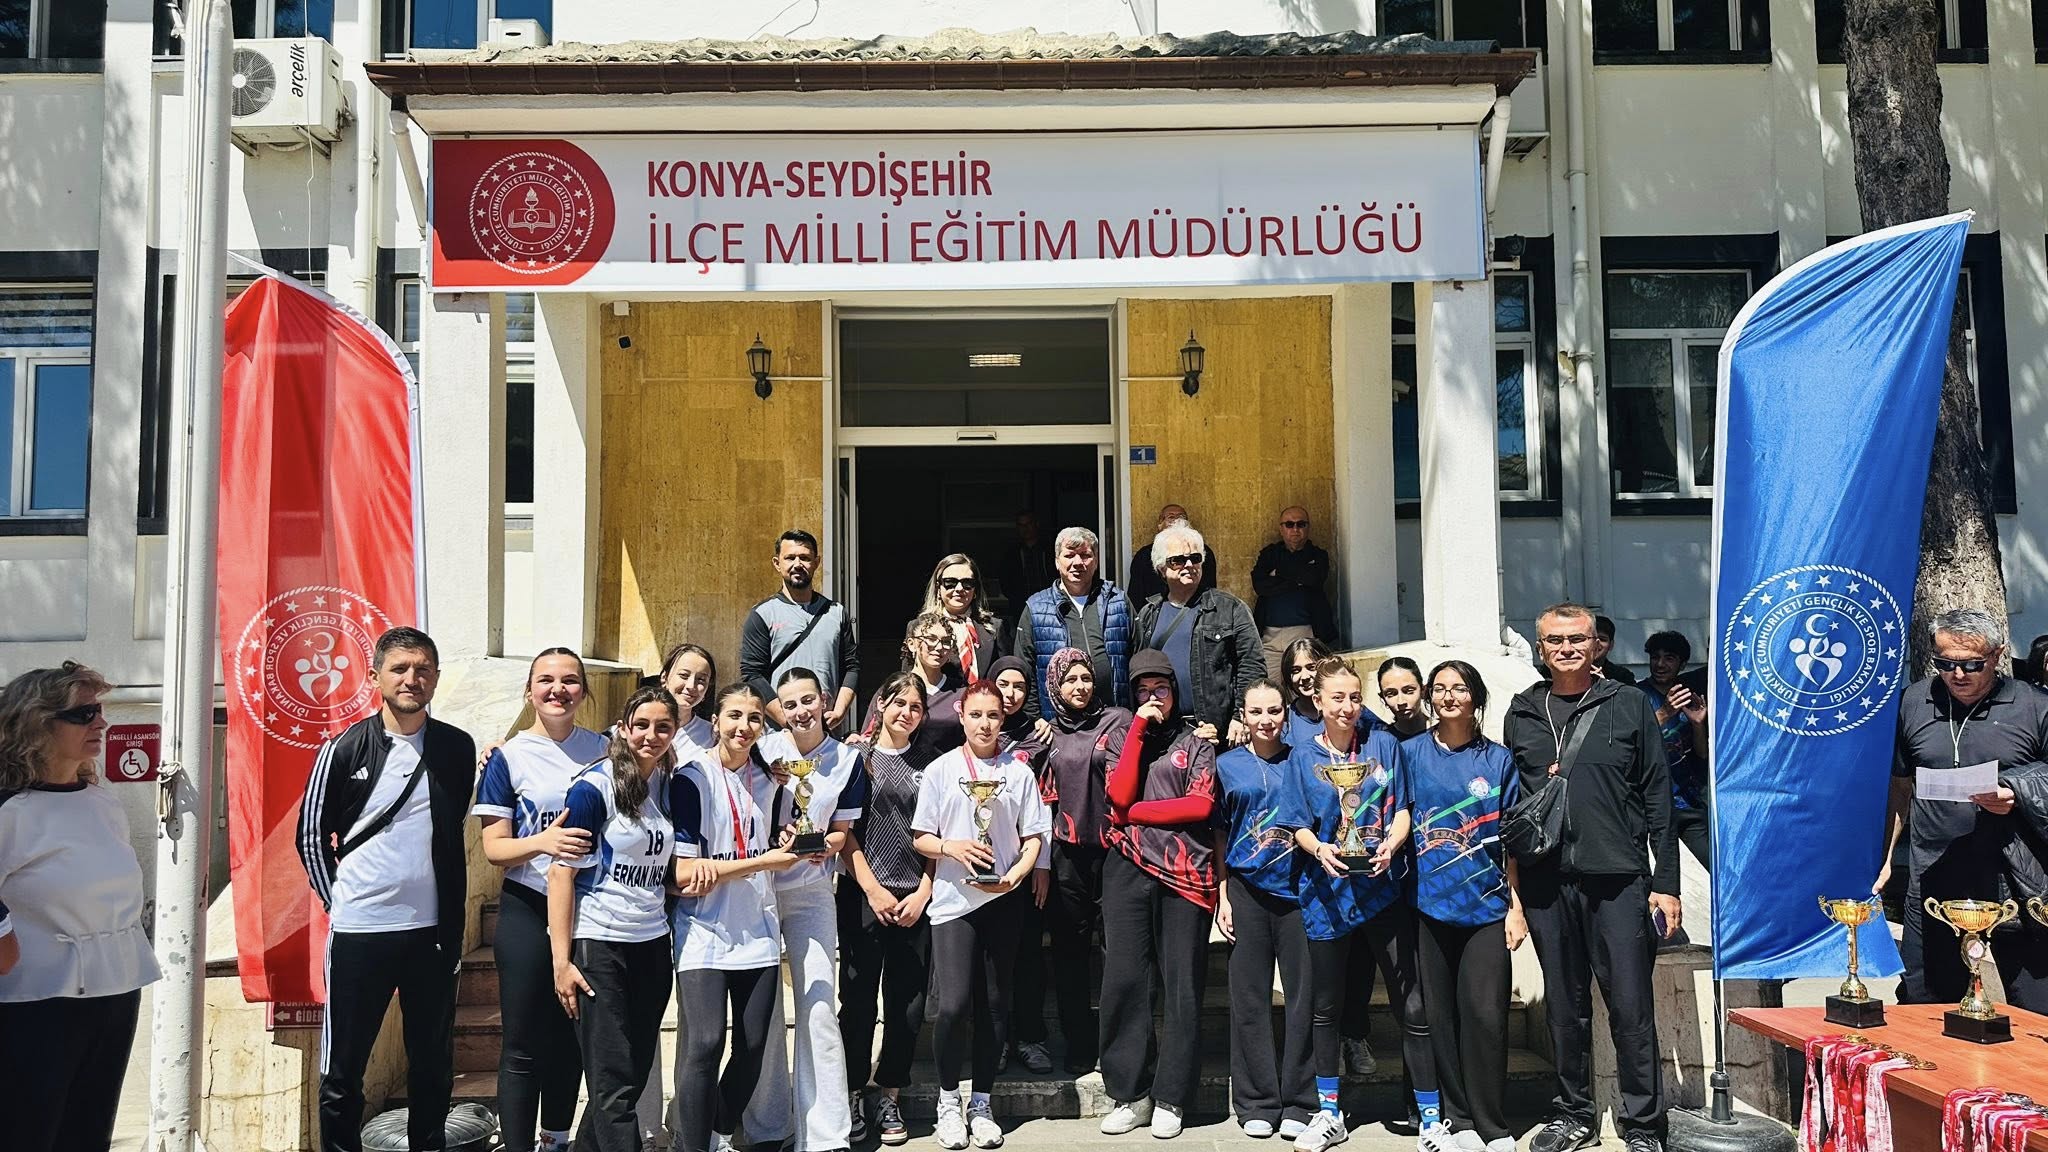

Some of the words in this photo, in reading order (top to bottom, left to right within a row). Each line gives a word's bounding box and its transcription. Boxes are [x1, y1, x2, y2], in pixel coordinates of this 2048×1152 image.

[290, 43, 307, 98] arçelik
[528, 174, 552, 185] MİLLİ
[648, 151, 993, 206] KONYA-SEYDİŞEHİR
[491, 174, 527, 222] CUMHURİYETİ
[552, 182, 572, 210] EĞİTİM
[495, 223, 525, 251] TÜRKİYE
[540, 211, 572, 251] BAKANLIĞI
[650, 212, 745, 274] İLÇE
[765, 212, 889, 264] MİLLİ
[910, 209, 1077, 262] EĞİTİM
[1098, 202, 1422, 259] MÜDÜRLÜĞÜ
[1137, 447, 1146, 461] 1
[1804, 596, 1857, 614] GENÇLİK
[1854, 611, 1870, 626] VE
[1757, 597, 1802, 664] CUMHURİYETİ
[1863, 625, 1877, 655] SPOR
[1758, 664, 1800, 704] TÜRKİYE
[1829, 656, 1876, 703] BAKANLIĞI
[644, 829, 664, 856] 18
[613, 862, 650, 887] ERKAN
